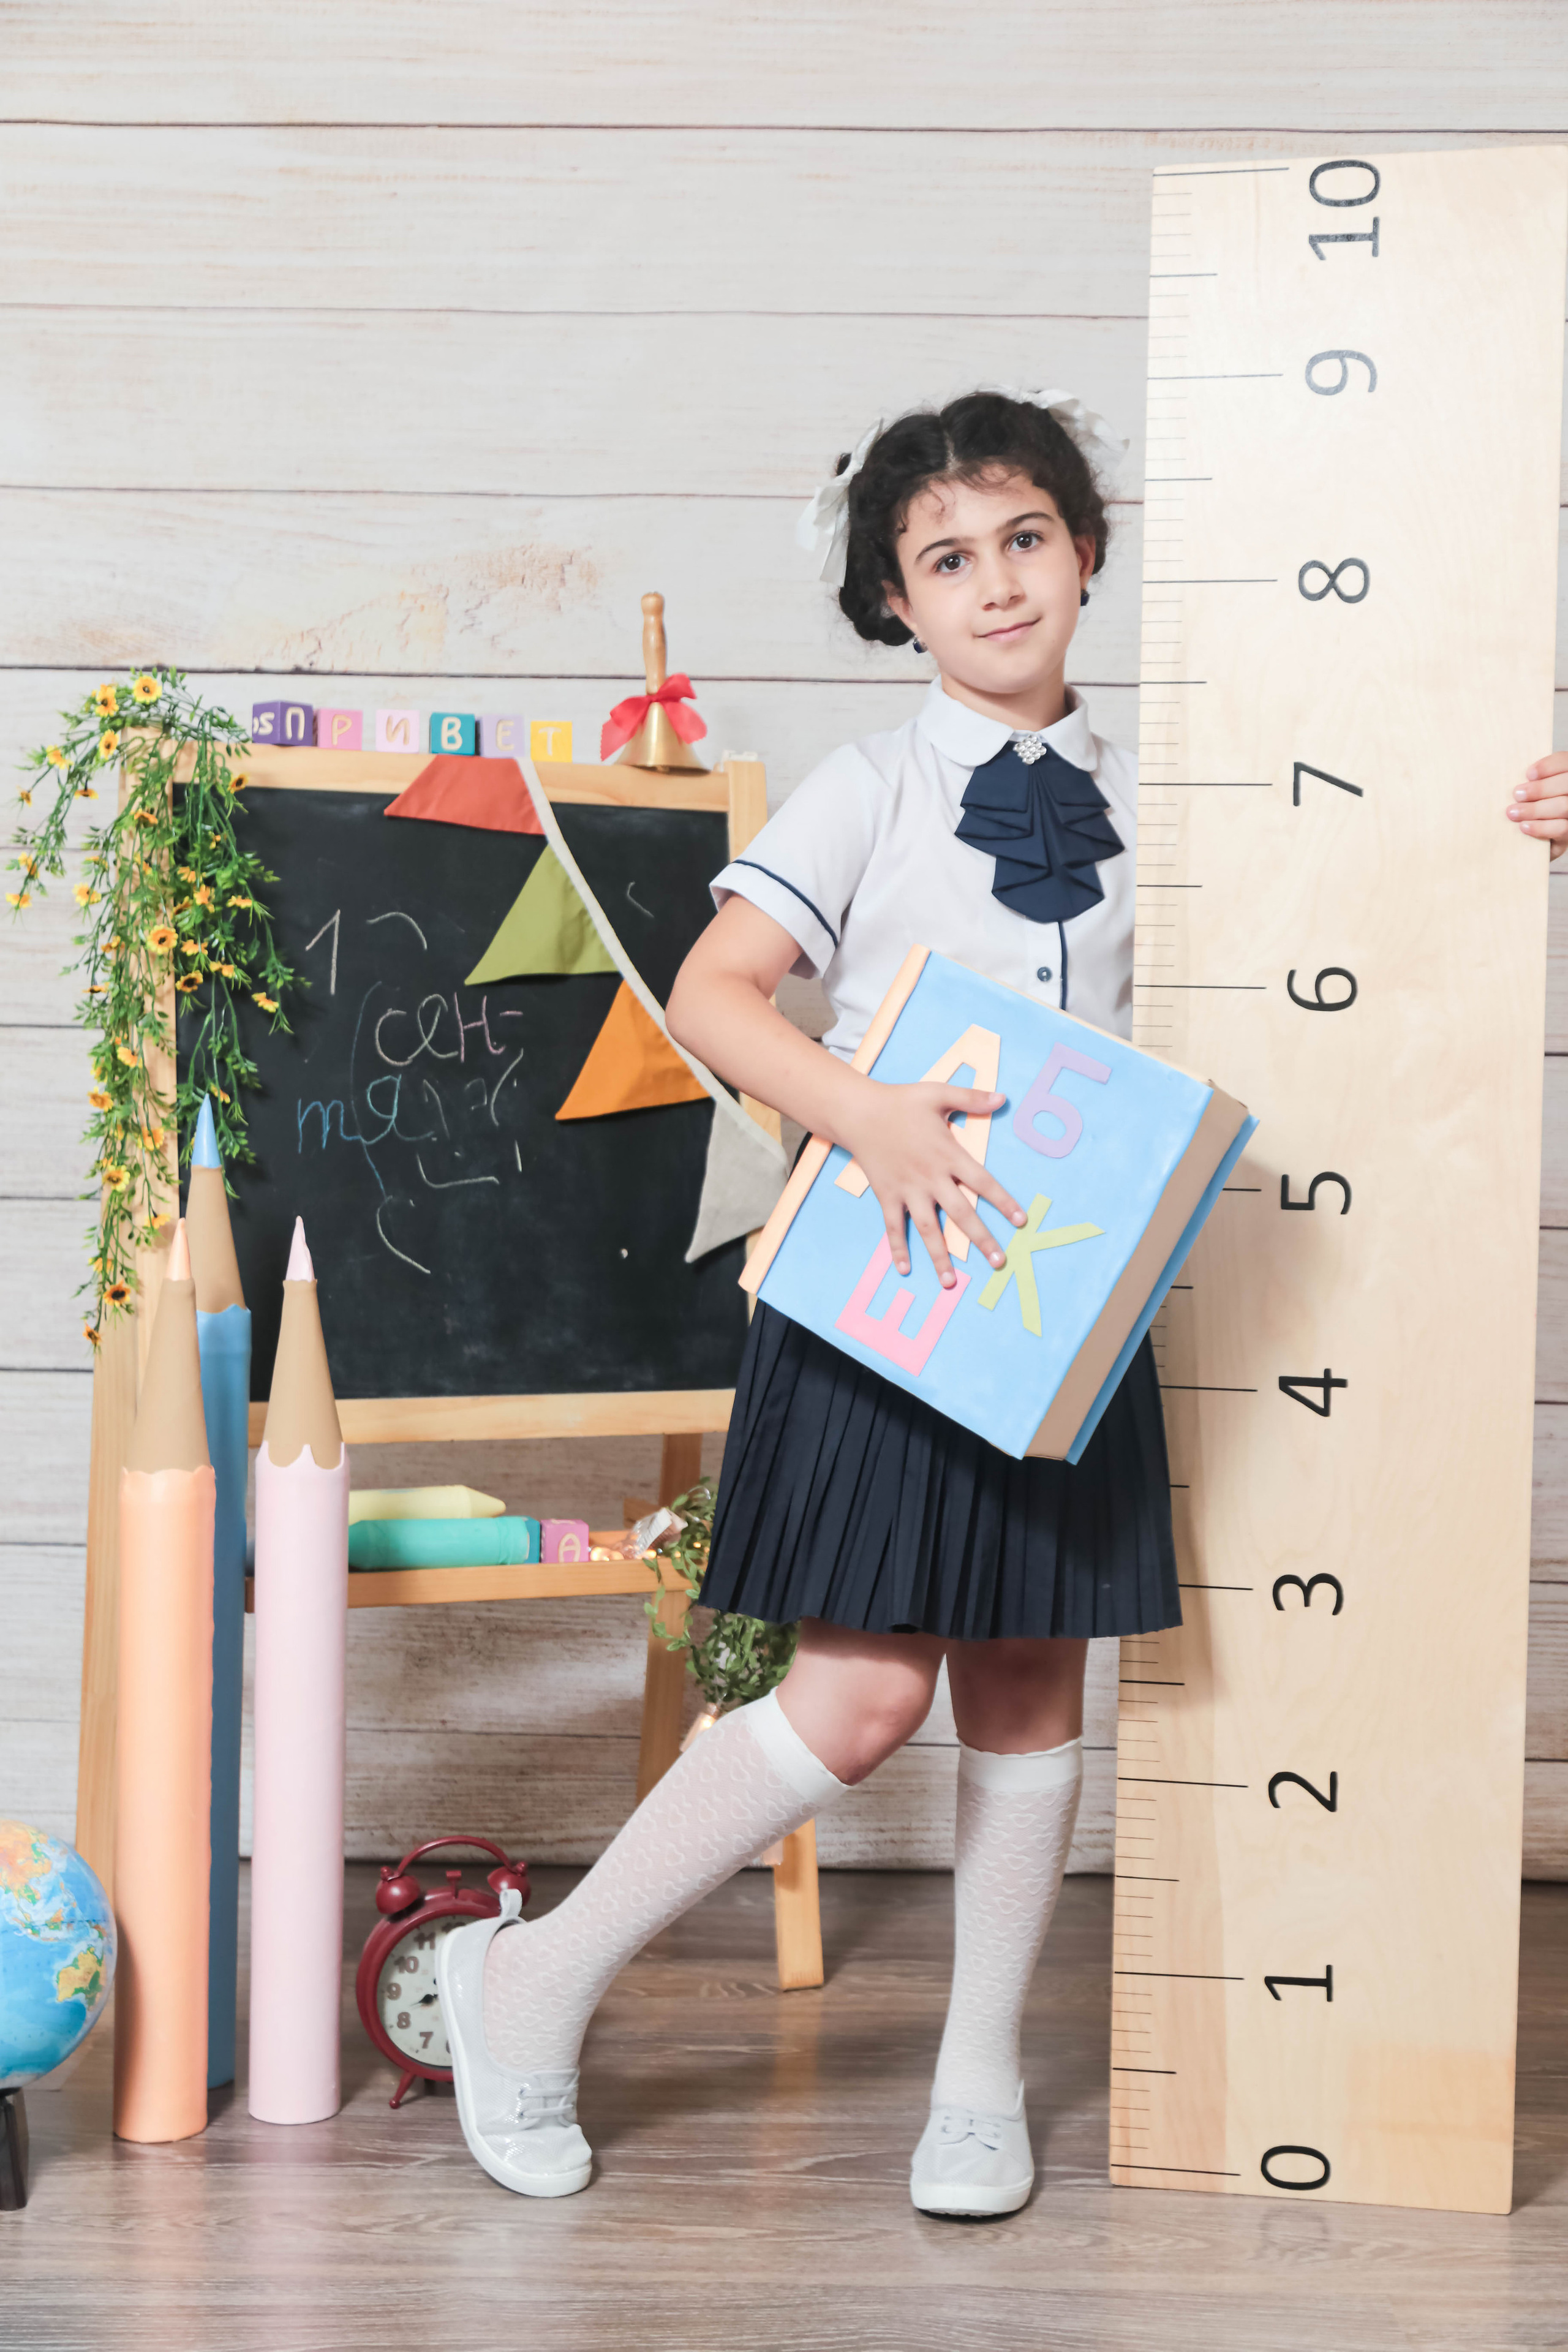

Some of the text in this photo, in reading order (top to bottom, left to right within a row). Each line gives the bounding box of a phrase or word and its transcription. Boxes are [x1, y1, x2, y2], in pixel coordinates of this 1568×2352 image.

[1309, 159, 1381, 261] 10
[1305, 349, 1378, 396] 9
[1298, 557, 1371, 603] 8
[1293, 763, 1363, 807] 7
[1287, 967, 1358, 1012] 6
[1280, 1171, 1351, 1215] 5
[1278, 1368, 1348, 1417] 4
[1272, 1573, 1344, 1616] 3
[1268, 1771, 1338, 1812] 2
[414, 1932, 435, 1950] 11
[394, 1956, 419, 1973] 10
[1264, 1964, 1333, 2002] 1
[386, 1983, 402, 2000] 9
[397, 2011, 411, 2030] 8
[420, 2031, 434, 2049] 7
[1261, 2145, 1331, 2191] 0
